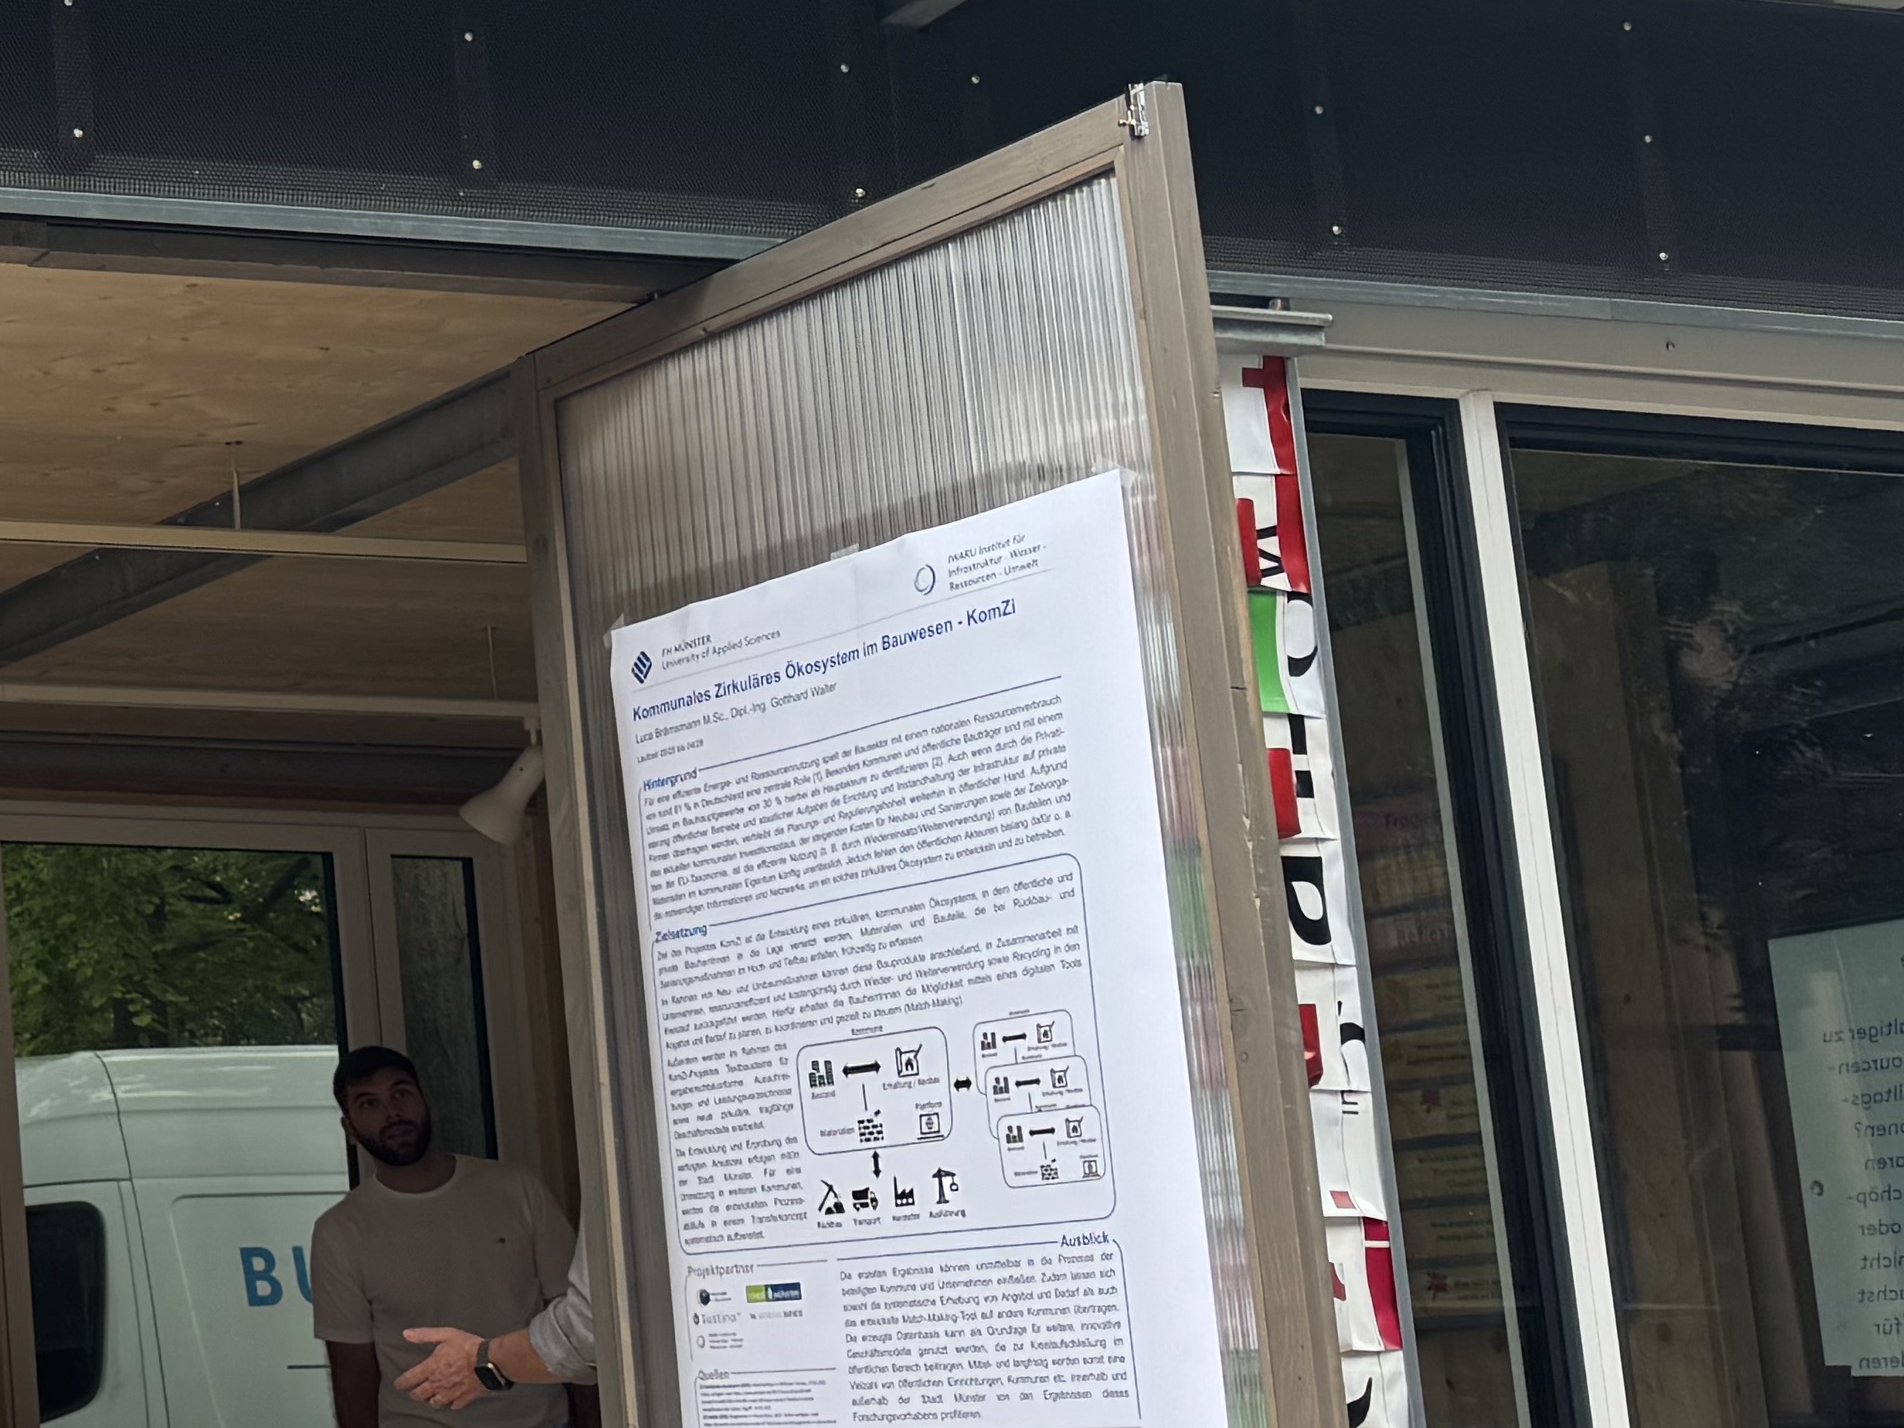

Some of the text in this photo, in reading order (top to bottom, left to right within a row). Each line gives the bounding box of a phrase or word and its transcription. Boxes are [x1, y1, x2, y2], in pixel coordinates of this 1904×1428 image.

[632, 689, 712, 722] Kommunales
[713, 670, 782, 699] Zirkuläres
[784, 647, 860, 680] Ökosystem
[862, 641, 879, 658] im
[880, 619, 953, 652] Bauwesen
[965, 597, 1016, 627] KomZi
[661, 652, 700, 671] University
[711, 638, 743, 657] Applied
[743, 629, 781, 647] Sciences
[634, 731, 654, 745] Luca
[769, 687, 809, 709] Gotthard
[809, 681, 837, 698] Walter
[642, 766, 698, 792] Hintergrund
[1058, 1230, 1110, 1248] Ausblick
